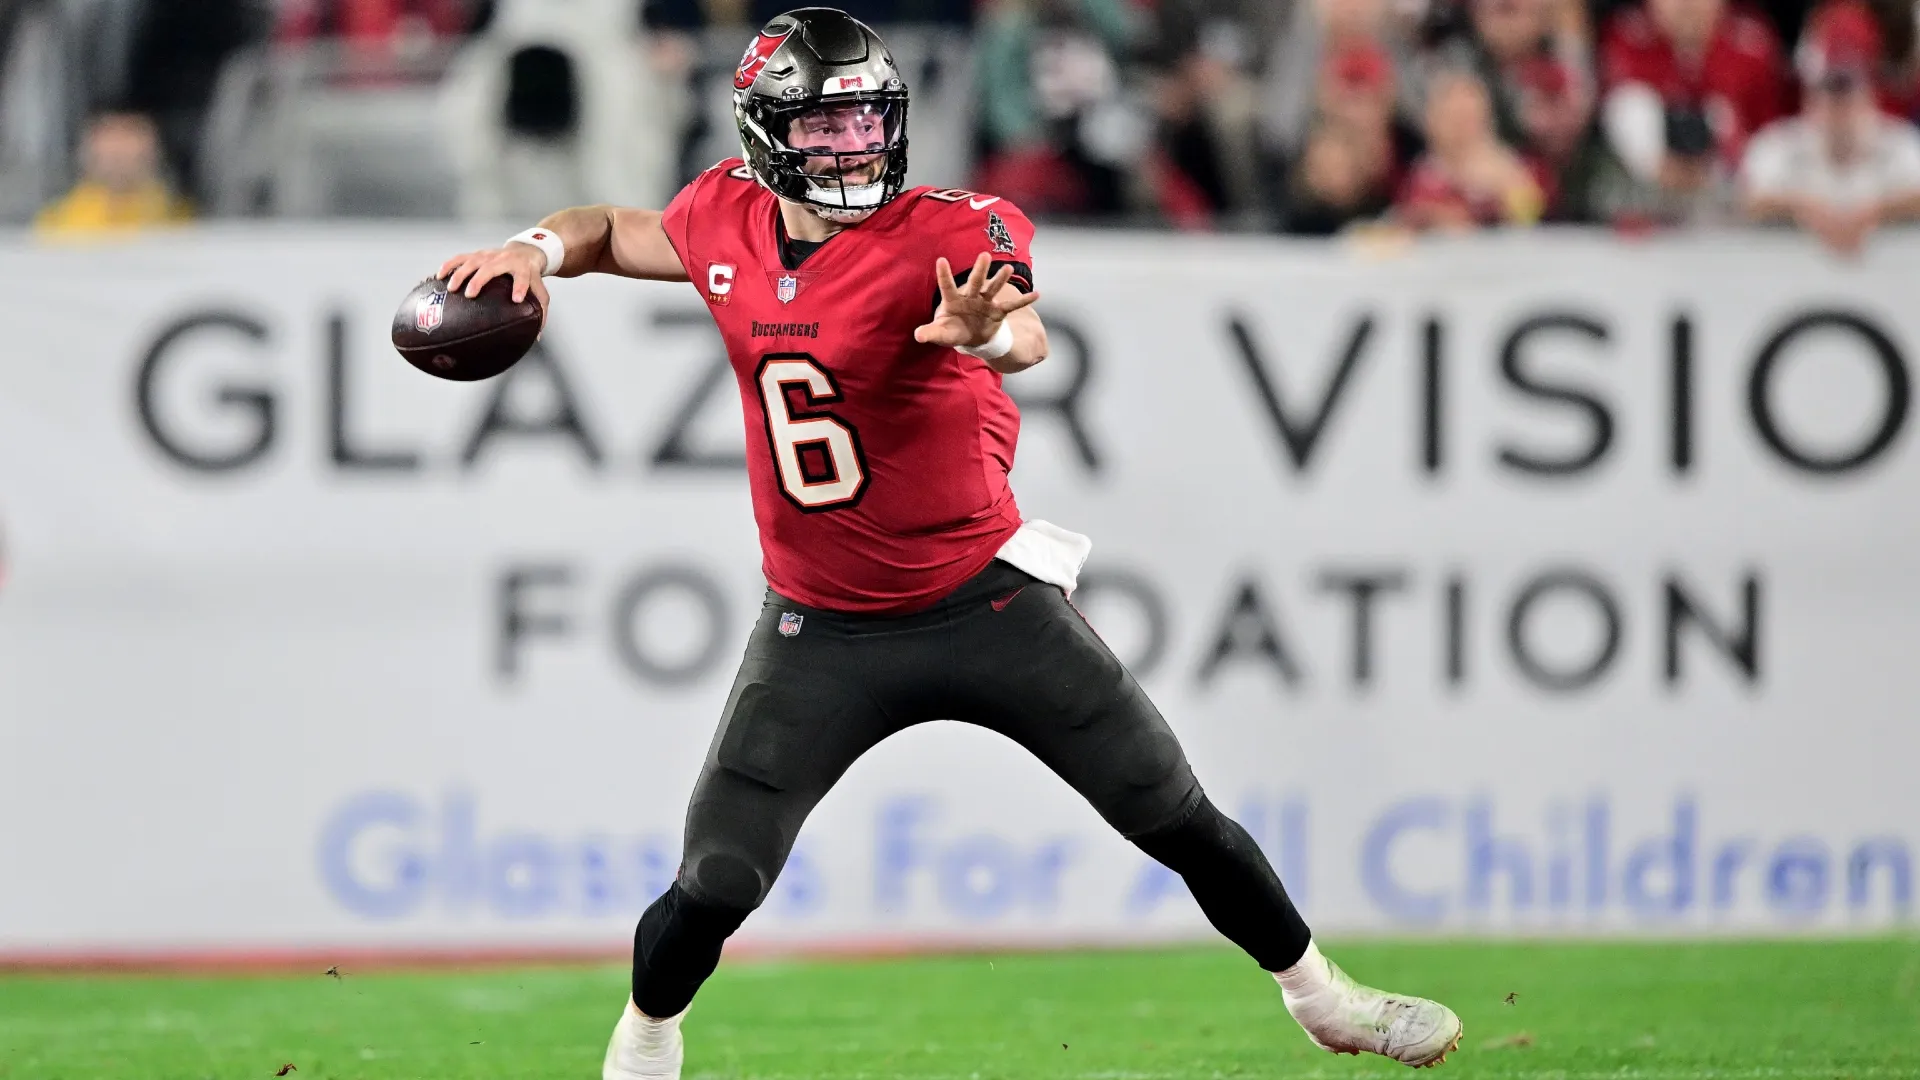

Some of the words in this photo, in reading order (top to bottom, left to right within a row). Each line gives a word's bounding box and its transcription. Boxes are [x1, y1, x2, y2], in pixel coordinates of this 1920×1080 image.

[418, 306, 439, 326] NFL
[709, 264, 733, 295] C
[751, 320, 819, 340] BUCCANEERS
[130, 307, 1104, 478] GLAZR
[1224, 305, 1915, 480] VISIO
[754, 352, 871, 514] 6
[493, 563, 1763, 690] FODATION
[873, 793, 1082, 916] For
[1358, 788, 1913, 918] Children
